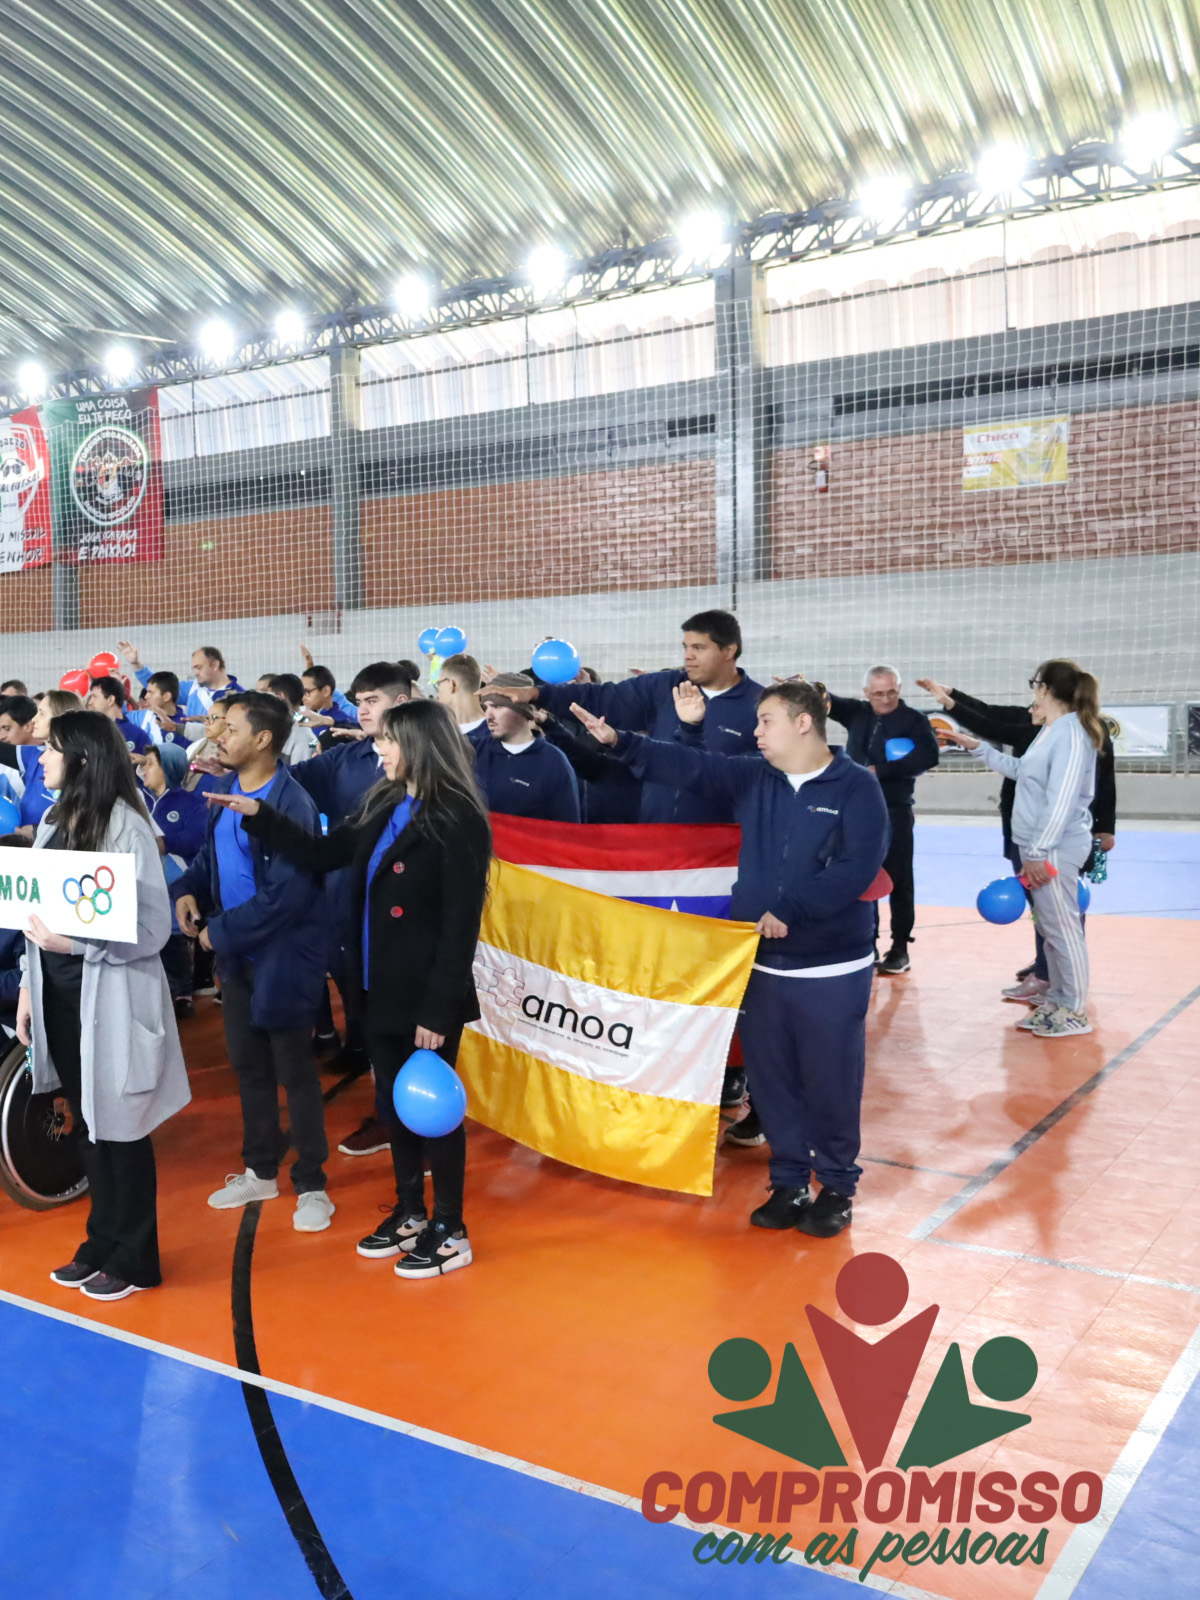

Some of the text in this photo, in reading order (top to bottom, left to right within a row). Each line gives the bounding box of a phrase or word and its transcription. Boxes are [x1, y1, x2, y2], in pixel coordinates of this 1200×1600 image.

[76, 397, 128, 412] UMA COISA
[521, 995, 633, 1050] amoa
